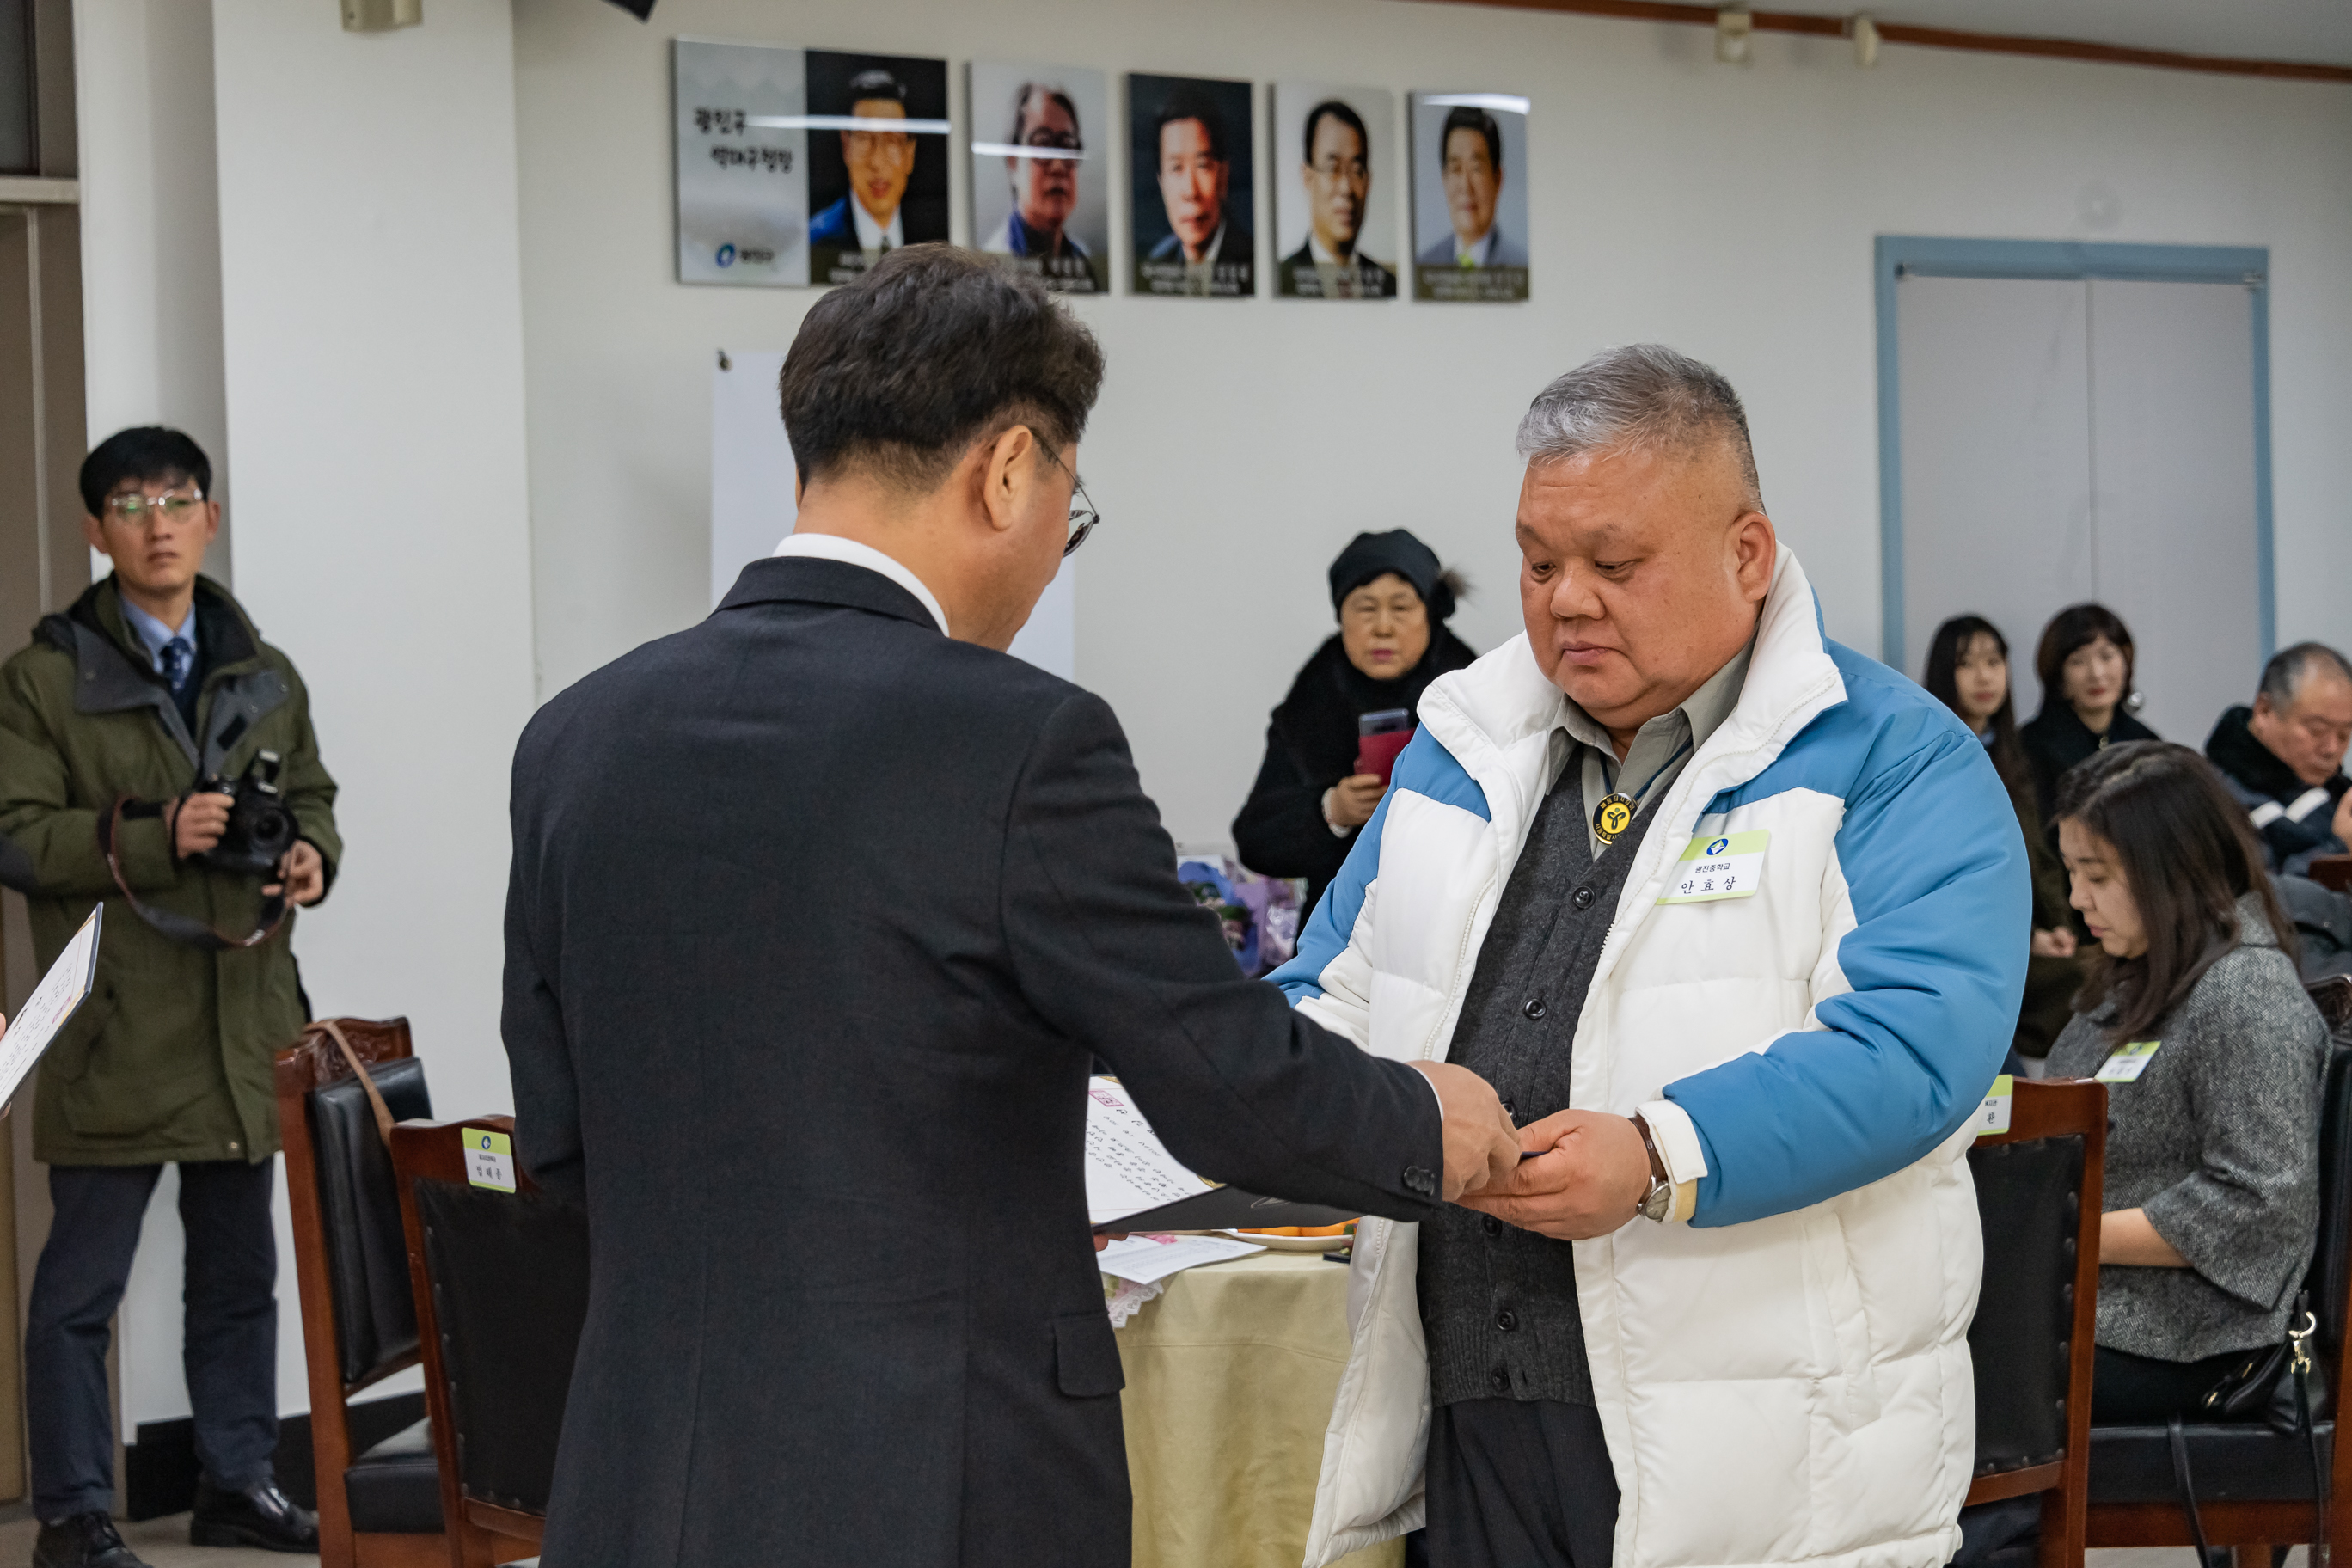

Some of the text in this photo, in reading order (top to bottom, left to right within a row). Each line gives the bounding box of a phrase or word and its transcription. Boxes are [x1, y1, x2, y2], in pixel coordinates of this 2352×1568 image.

[694, 107, 745, 136] 광진구
[1695, 862, 1731, 874] 광진중학교
[1681, 876, 1736, 894] 안 효 상
